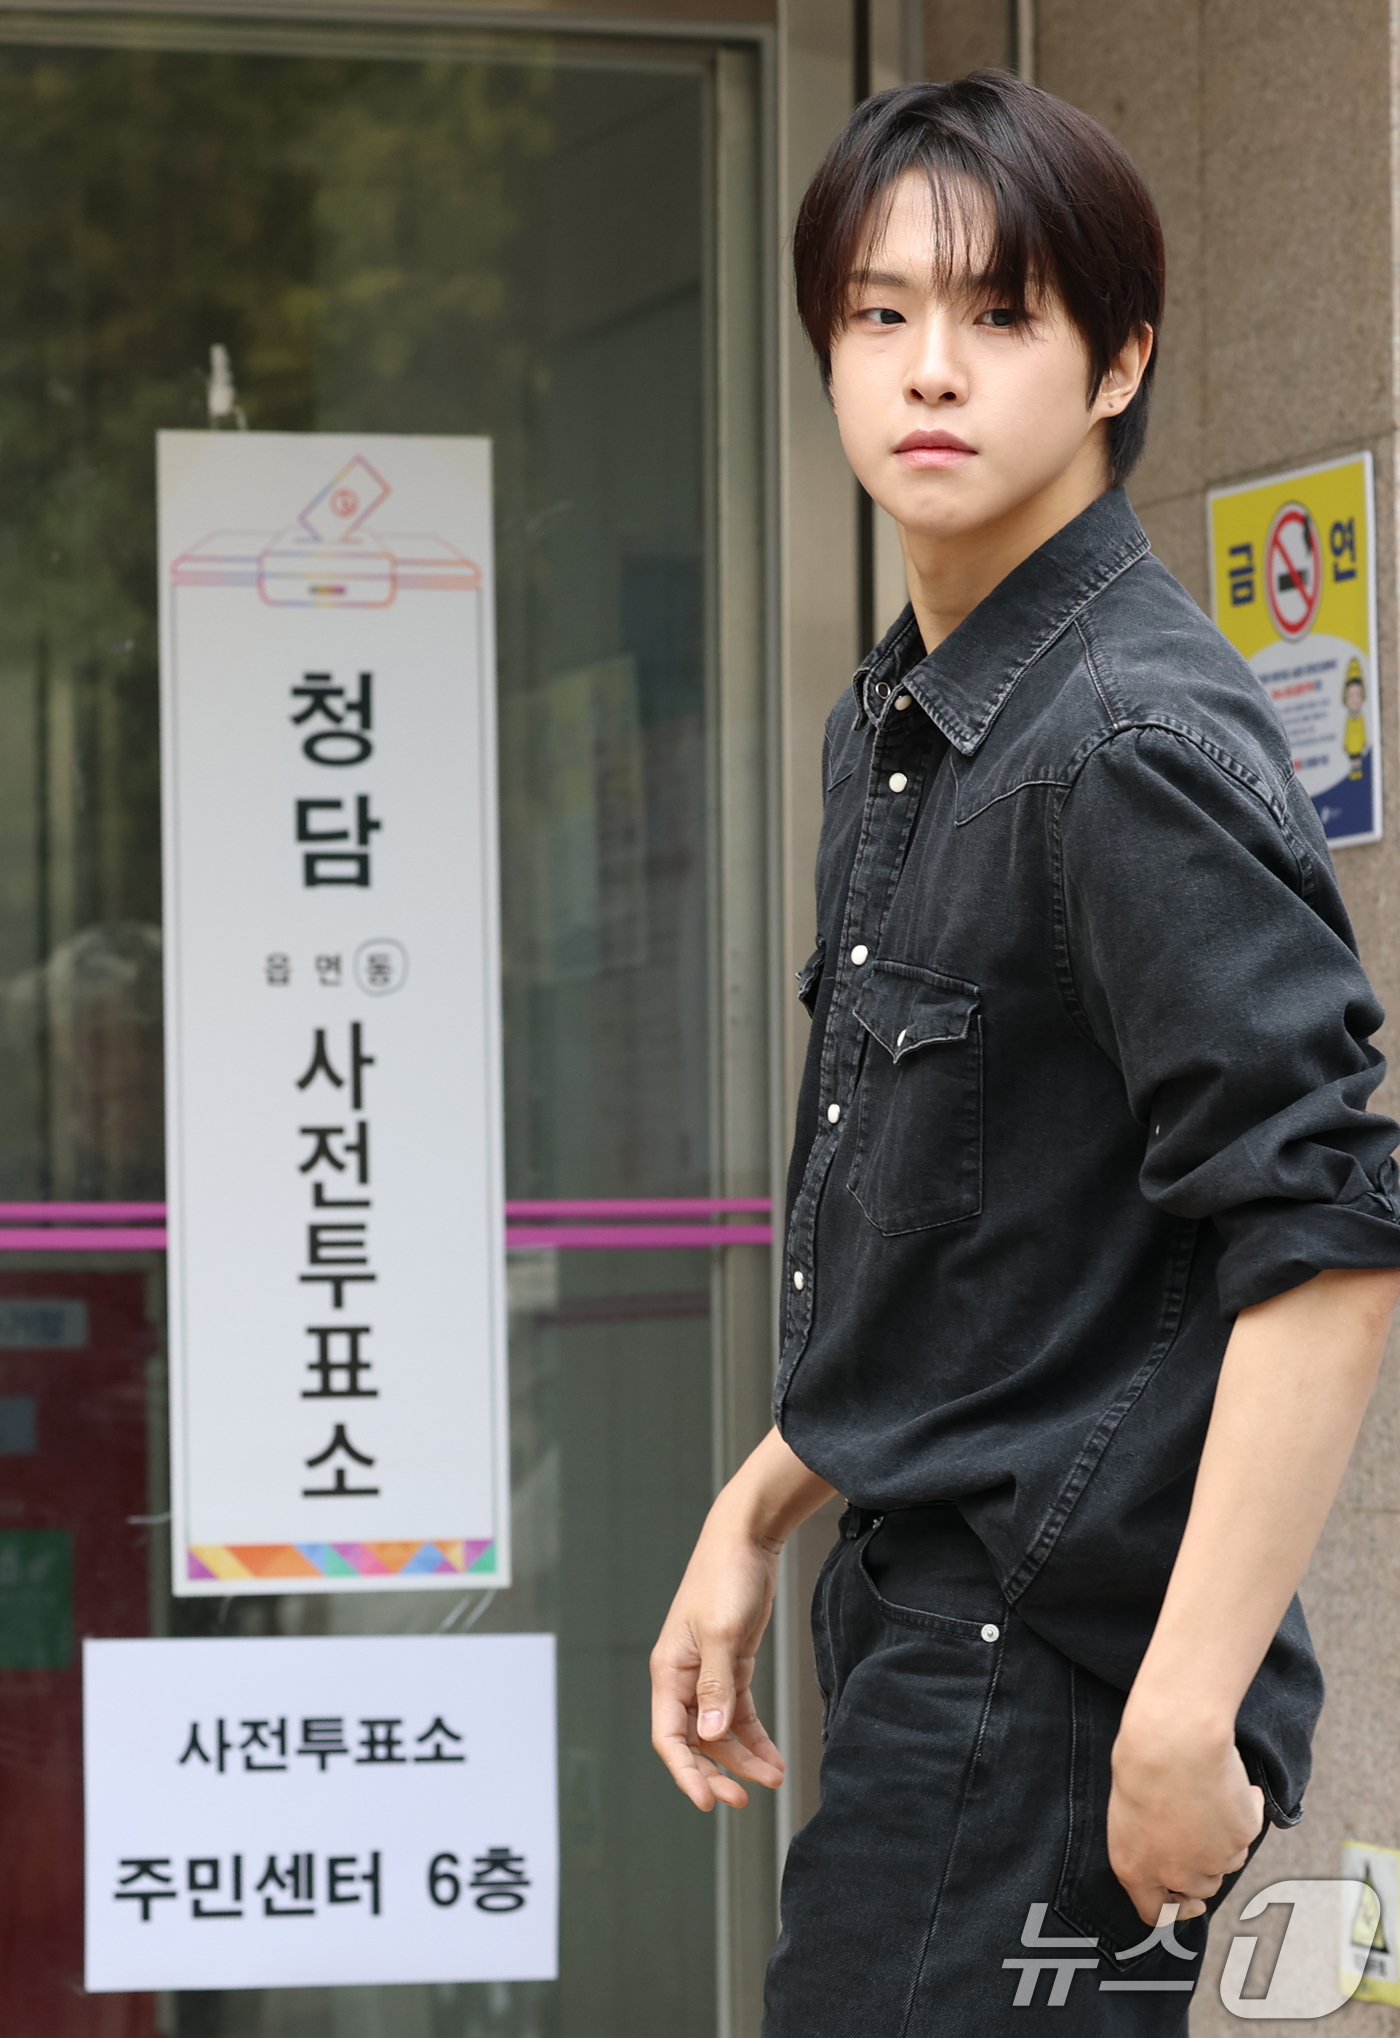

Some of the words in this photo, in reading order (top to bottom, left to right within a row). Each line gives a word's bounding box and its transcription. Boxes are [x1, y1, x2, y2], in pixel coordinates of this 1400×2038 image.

[1229, 542, 1255, 607] 금
[1330, 517, 1358, 583] 연
[290, 670, 383, 889] 청담
[314, 954, 343, 987] 면
[366, 953, 393, 987] 동
[295, 1020, 381, 1499] 사전투표소
[178, 1716, 466, 1774] 사전투표소
[113, 1850, 382, 1923] 주민센터
[427, 1846, 532, 1915] 6층
